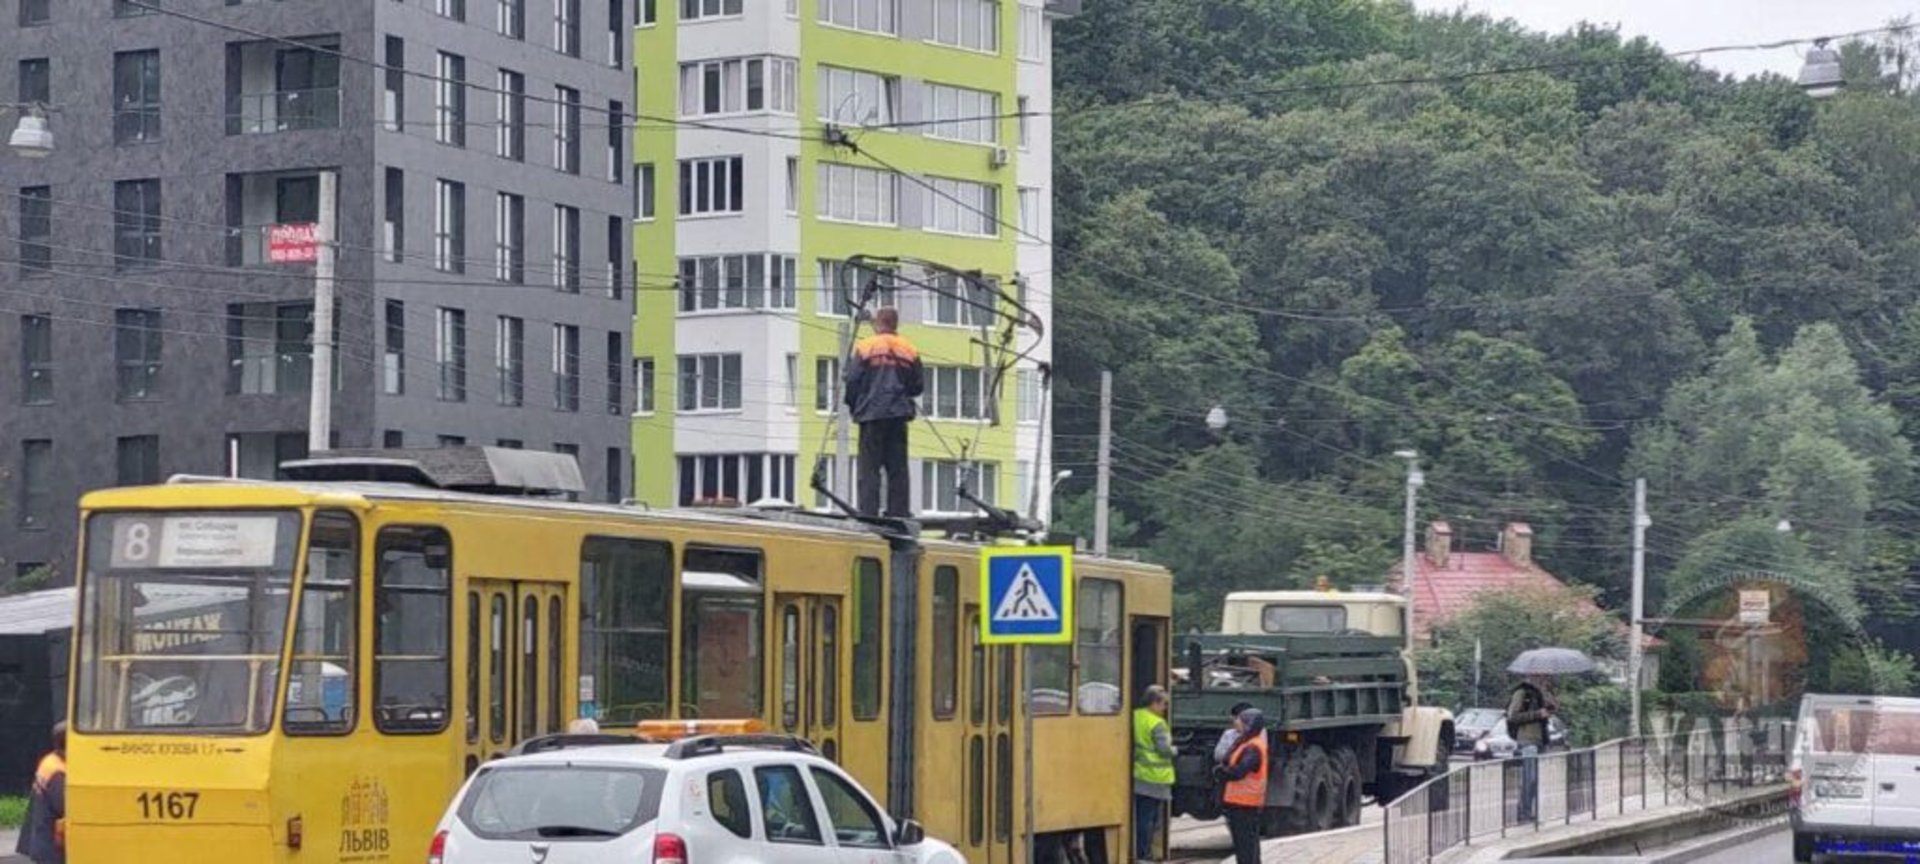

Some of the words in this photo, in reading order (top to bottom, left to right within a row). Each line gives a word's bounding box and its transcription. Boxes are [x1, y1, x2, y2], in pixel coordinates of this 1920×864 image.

[124, 522, 151, 561] 8
[137, 791, 200, 819] 1167
[339, 828, 390, 853] ЛЬВІВ
